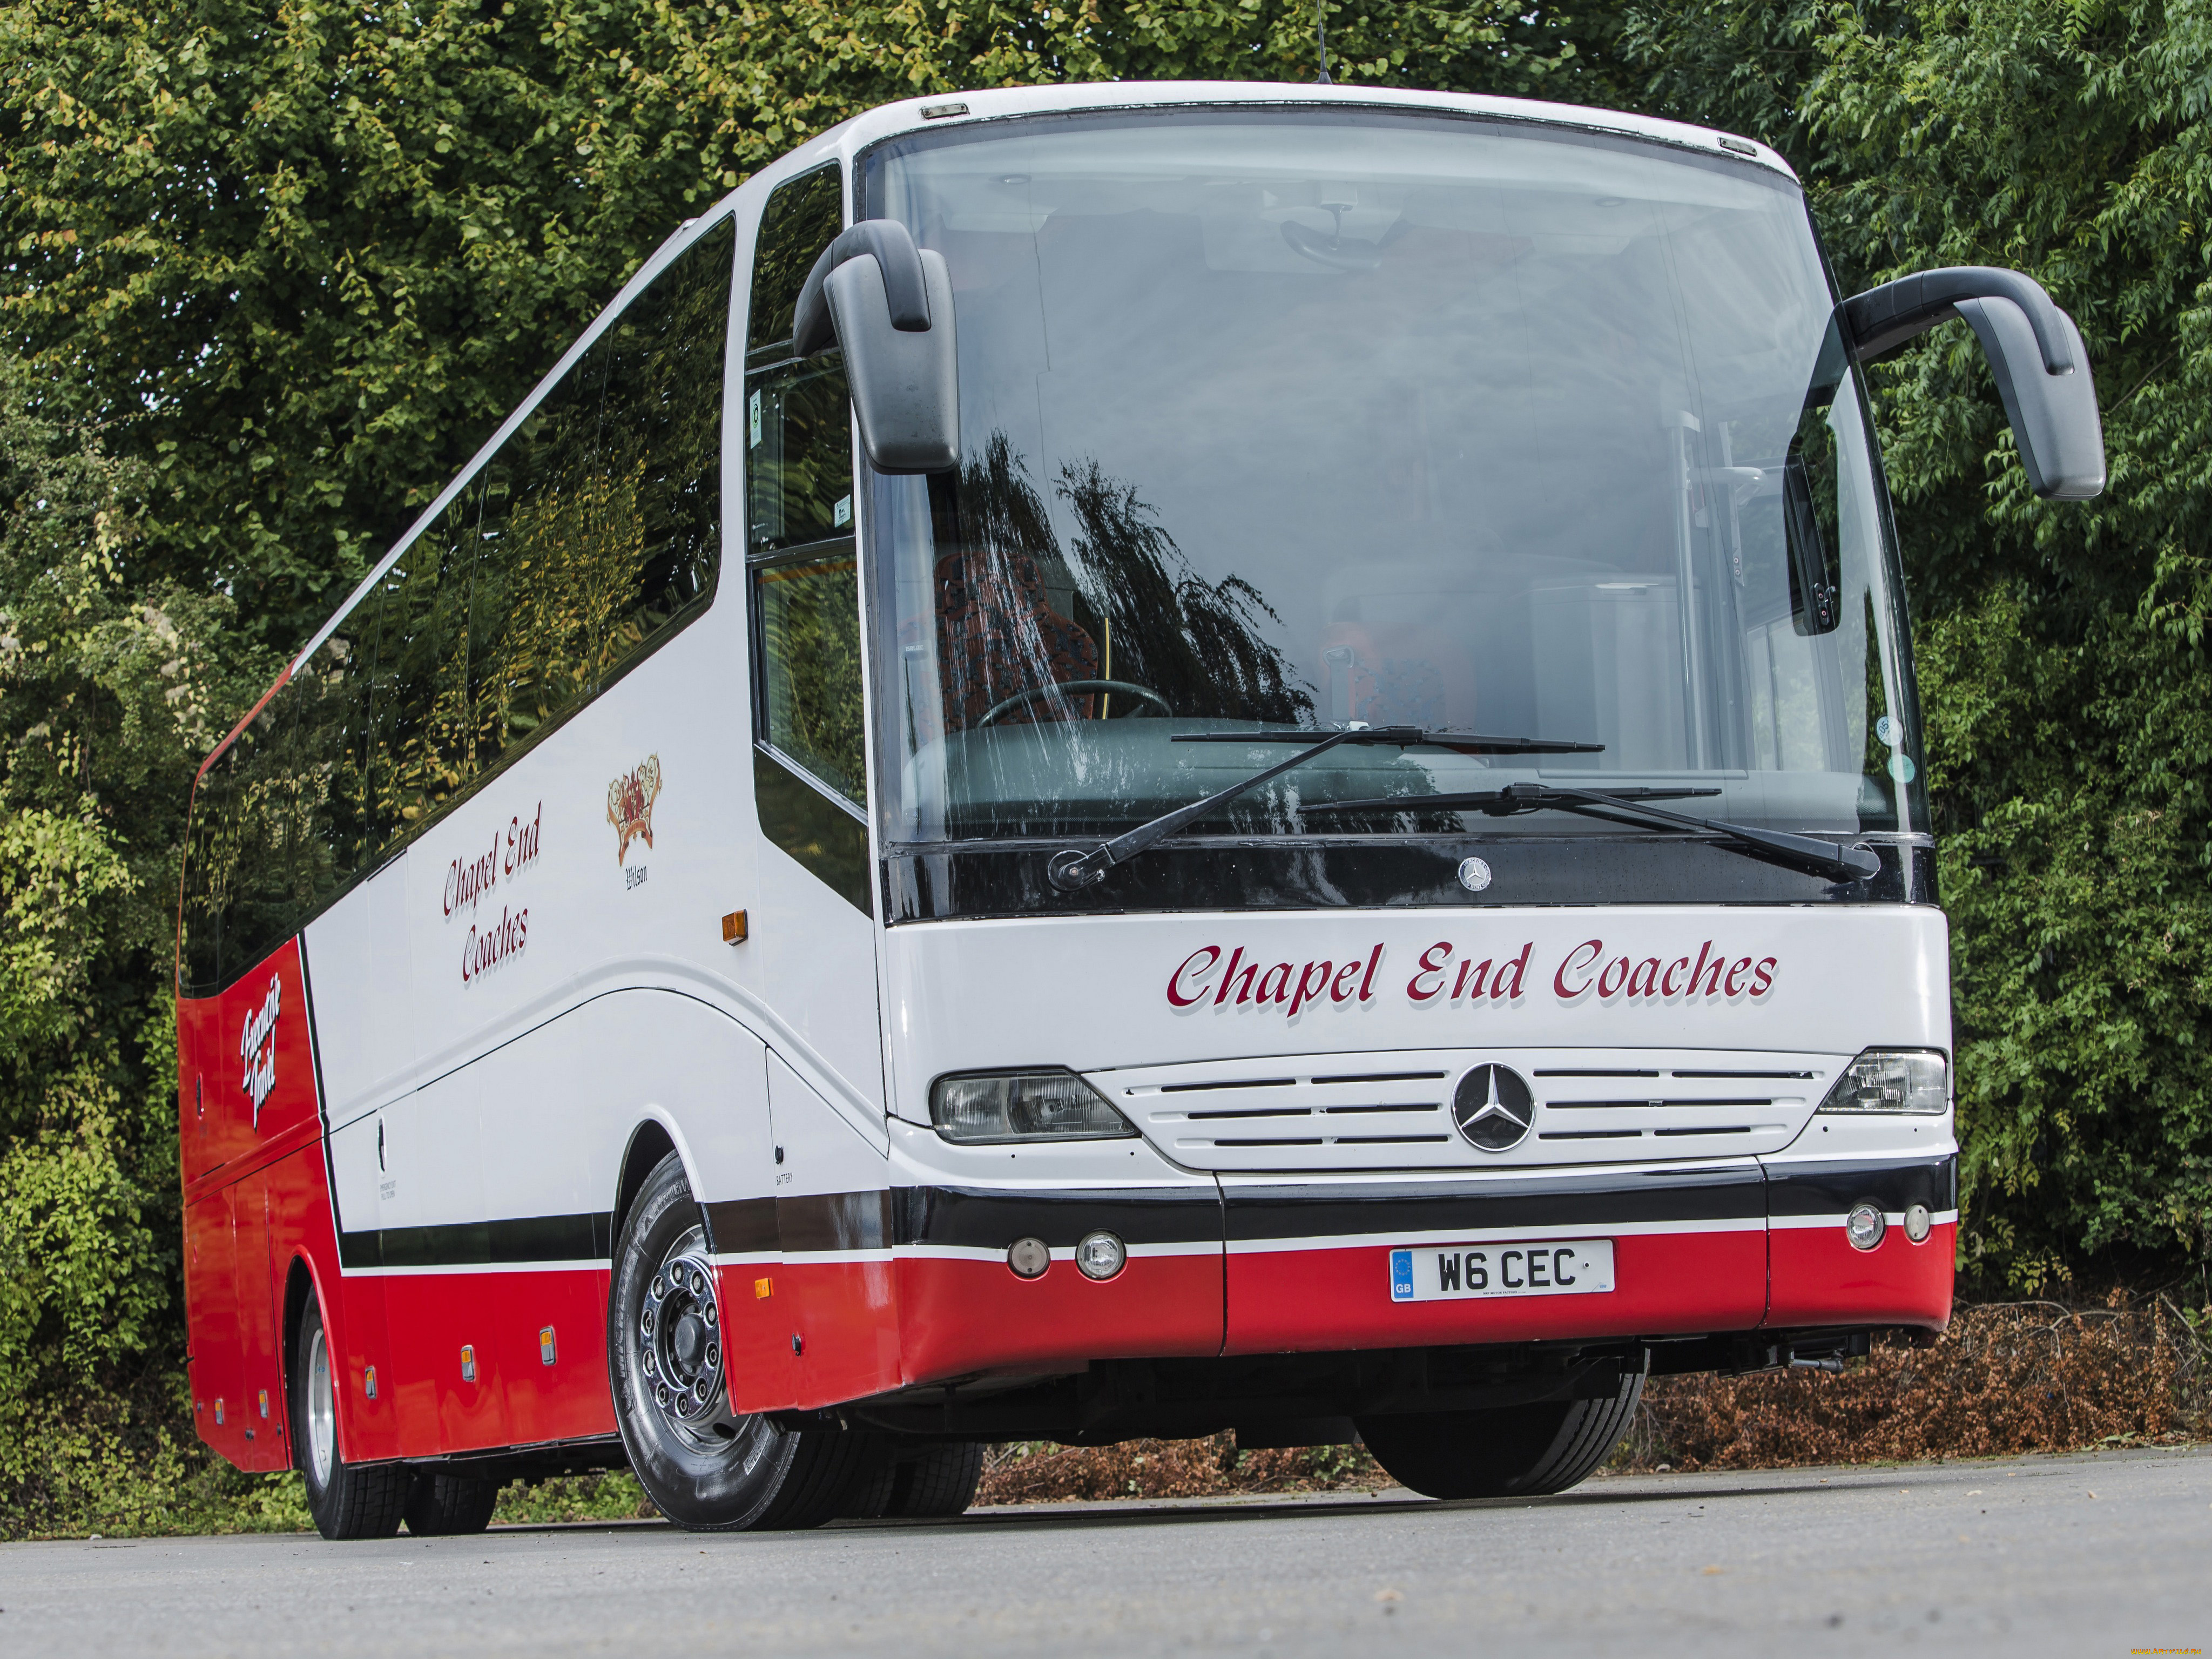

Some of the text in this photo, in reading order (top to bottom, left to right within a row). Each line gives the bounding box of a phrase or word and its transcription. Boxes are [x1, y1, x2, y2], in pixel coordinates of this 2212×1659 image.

[443, 799, 543, 918] Chapel End
[625, 866, 648, 891] Wilson
[462, 904, 529, 982] Coaches
[1166, 939, 1778, 1017] Chapel End Coaches
[776, 1172, 793, 1186] BATTERY
[1395, 1283, 1411, 1293] GB
[1438, 1248, 1576, 1292] W6 CEC
